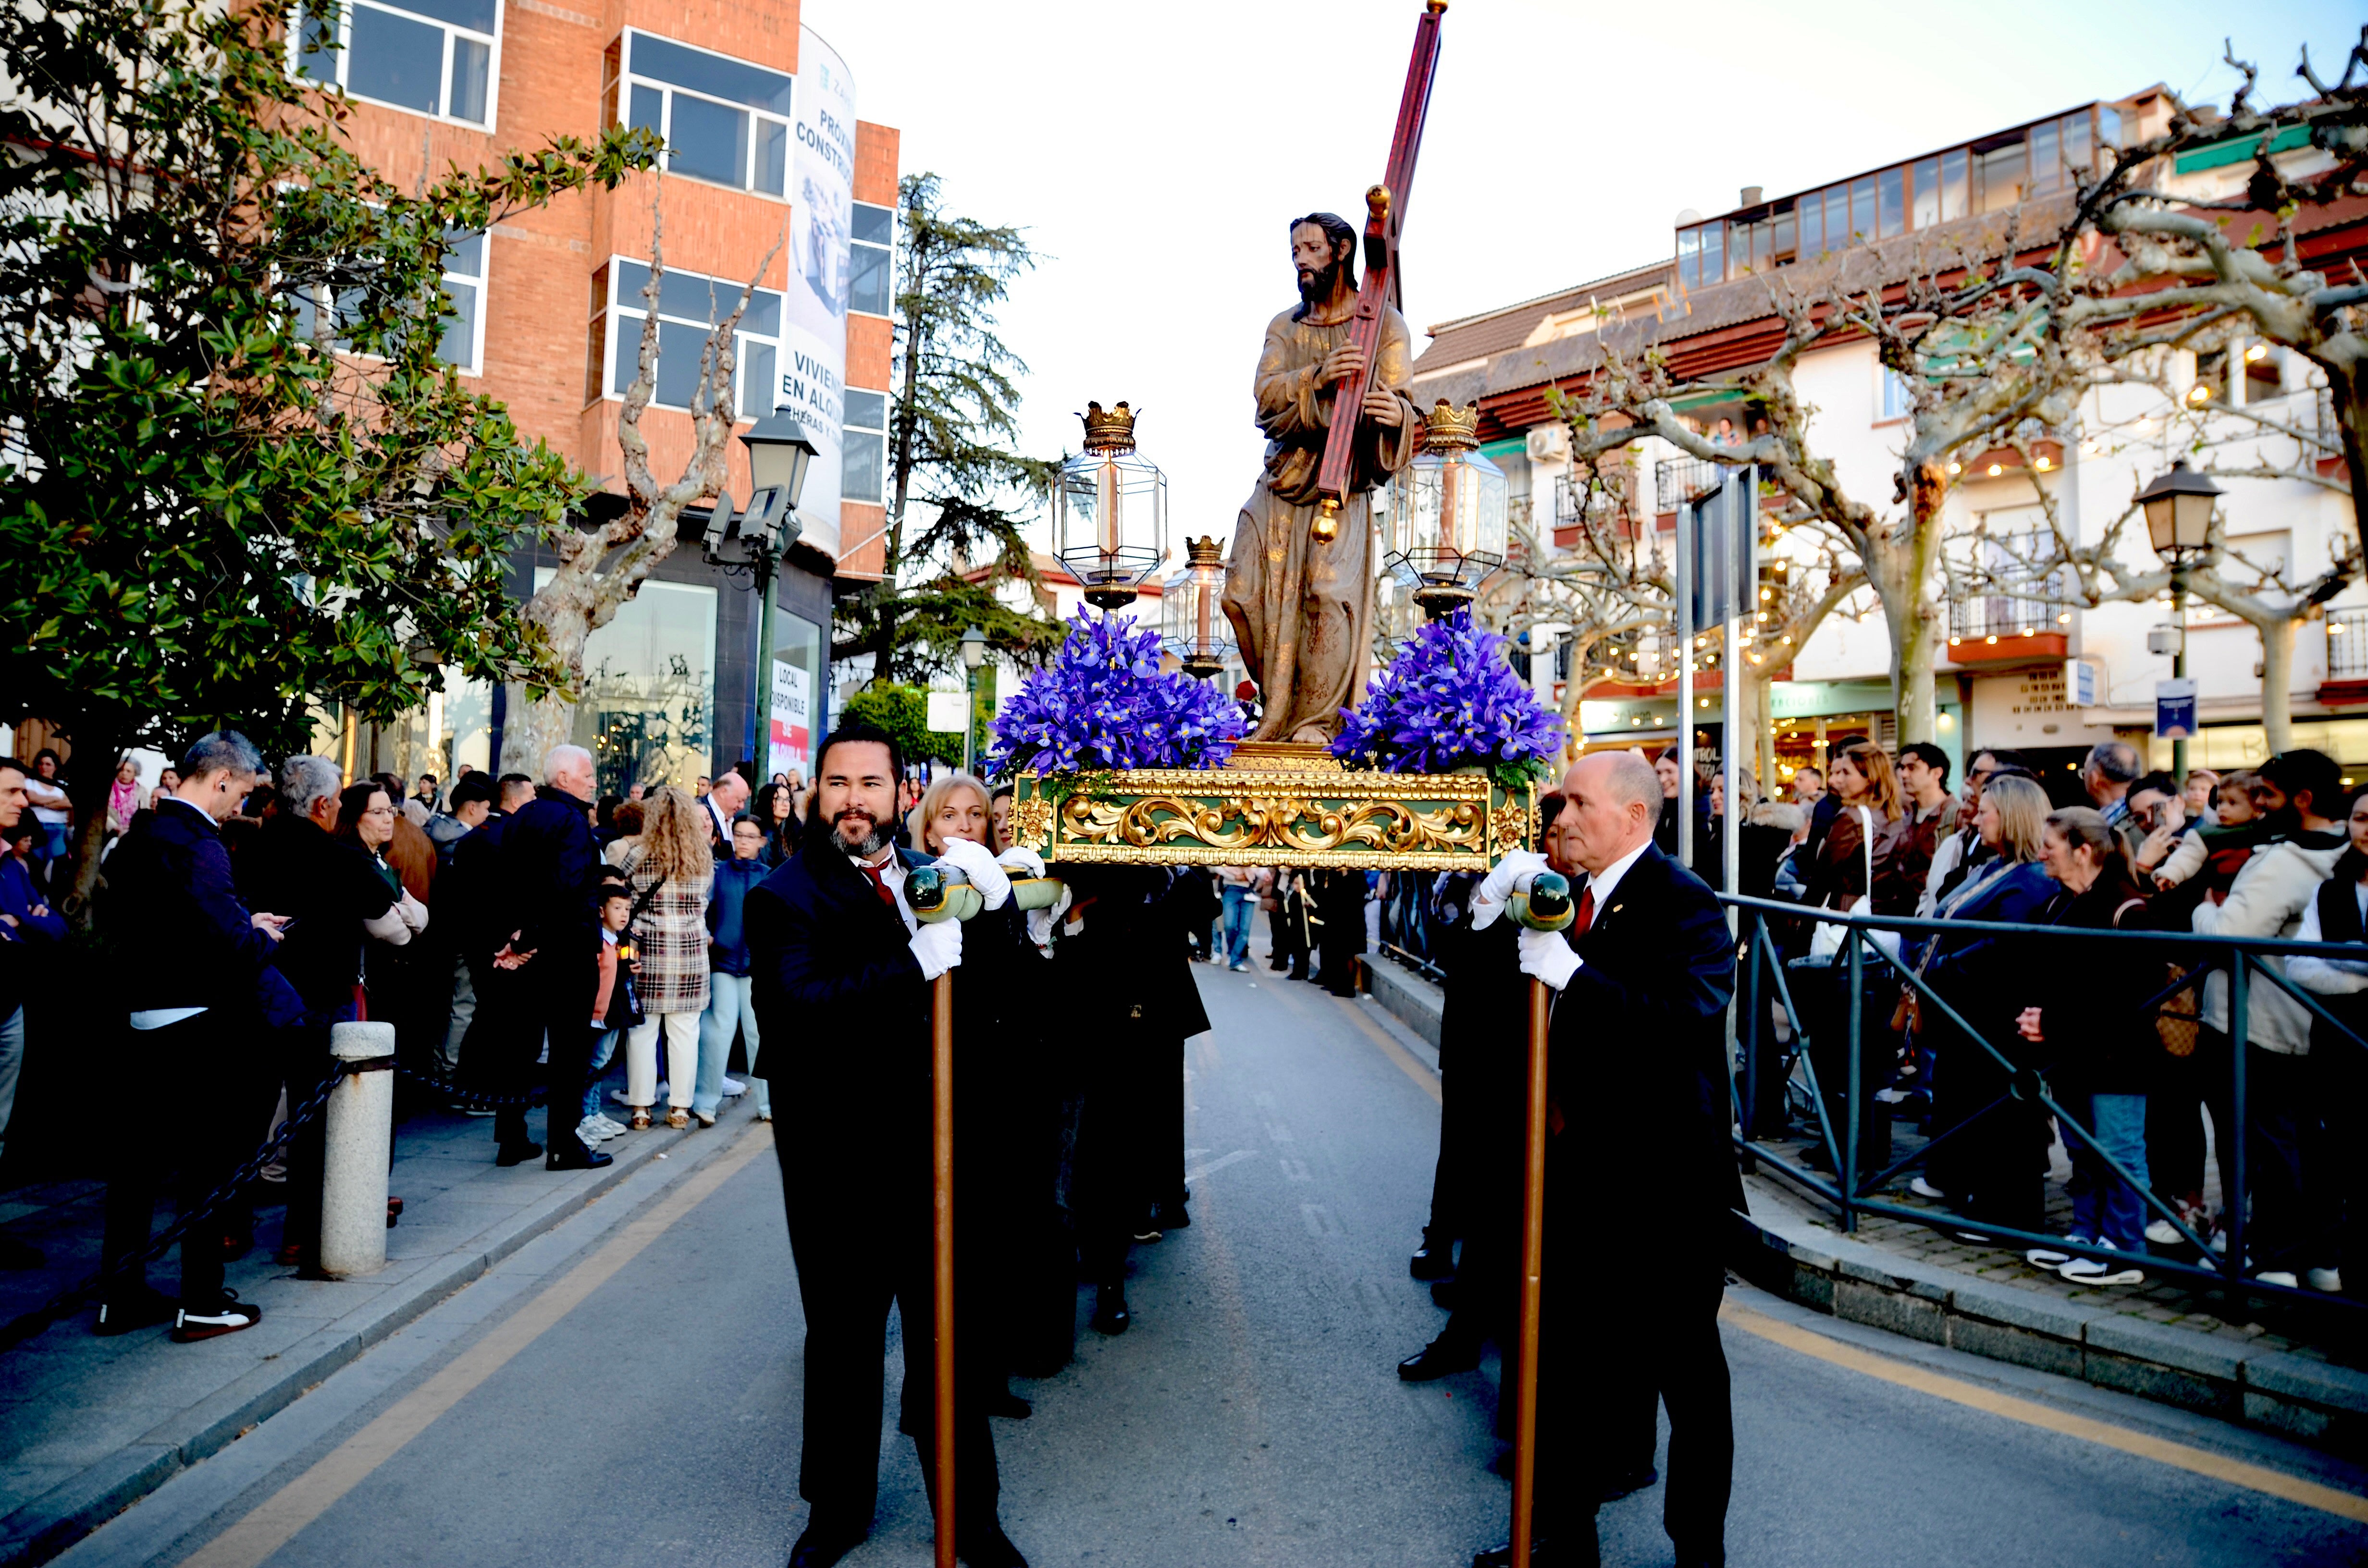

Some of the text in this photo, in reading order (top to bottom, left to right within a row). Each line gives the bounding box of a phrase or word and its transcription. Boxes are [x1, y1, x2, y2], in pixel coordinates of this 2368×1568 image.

[783, 374, 803, 400] EN
[779, 667, 797, 688] LOCAL
[771, 691, 804, 715] DISPONIBLE
[782, 722, 792, 738] SE
